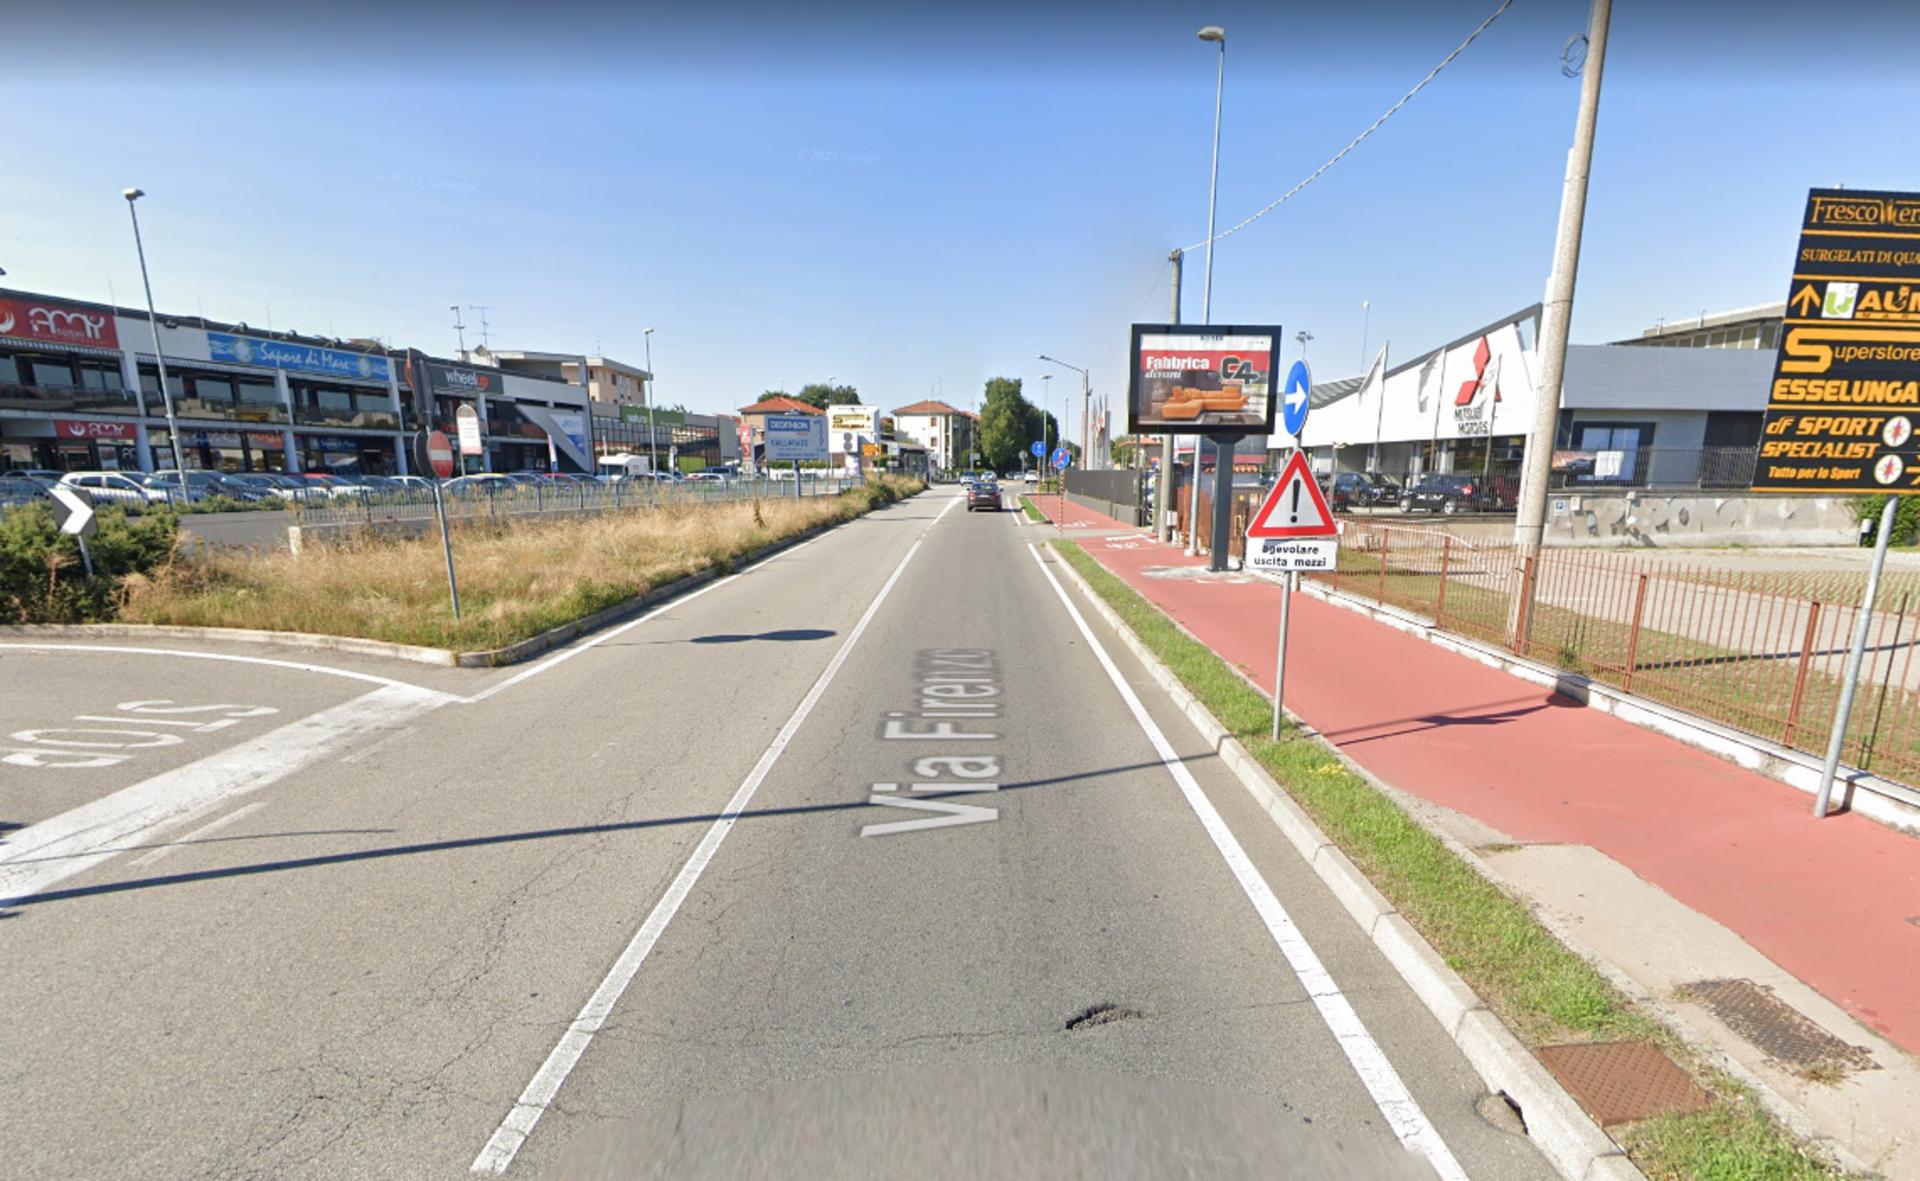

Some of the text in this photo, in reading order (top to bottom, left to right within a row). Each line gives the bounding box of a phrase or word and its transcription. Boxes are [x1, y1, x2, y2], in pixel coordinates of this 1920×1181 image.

[1801, 247, 1876, 263] SURGELATI
[1877, 249, 1892, 264] DI
[28, 307, 105, 339] AMY
[260, 342, 349, 370] Sapore di Mare
[1146, 356, 1210, 370] Fabbrica
[1773, 378, 1919, 403] ESSELUNGA
[1796, 416, 1885, 436] SPORT
[1760, 441, 1880, 459] SPECIALIST
[1768, 466, 1861, 480] Tutto per lo Sport
[1254, 556, 1327, 567] uscita mezzi
